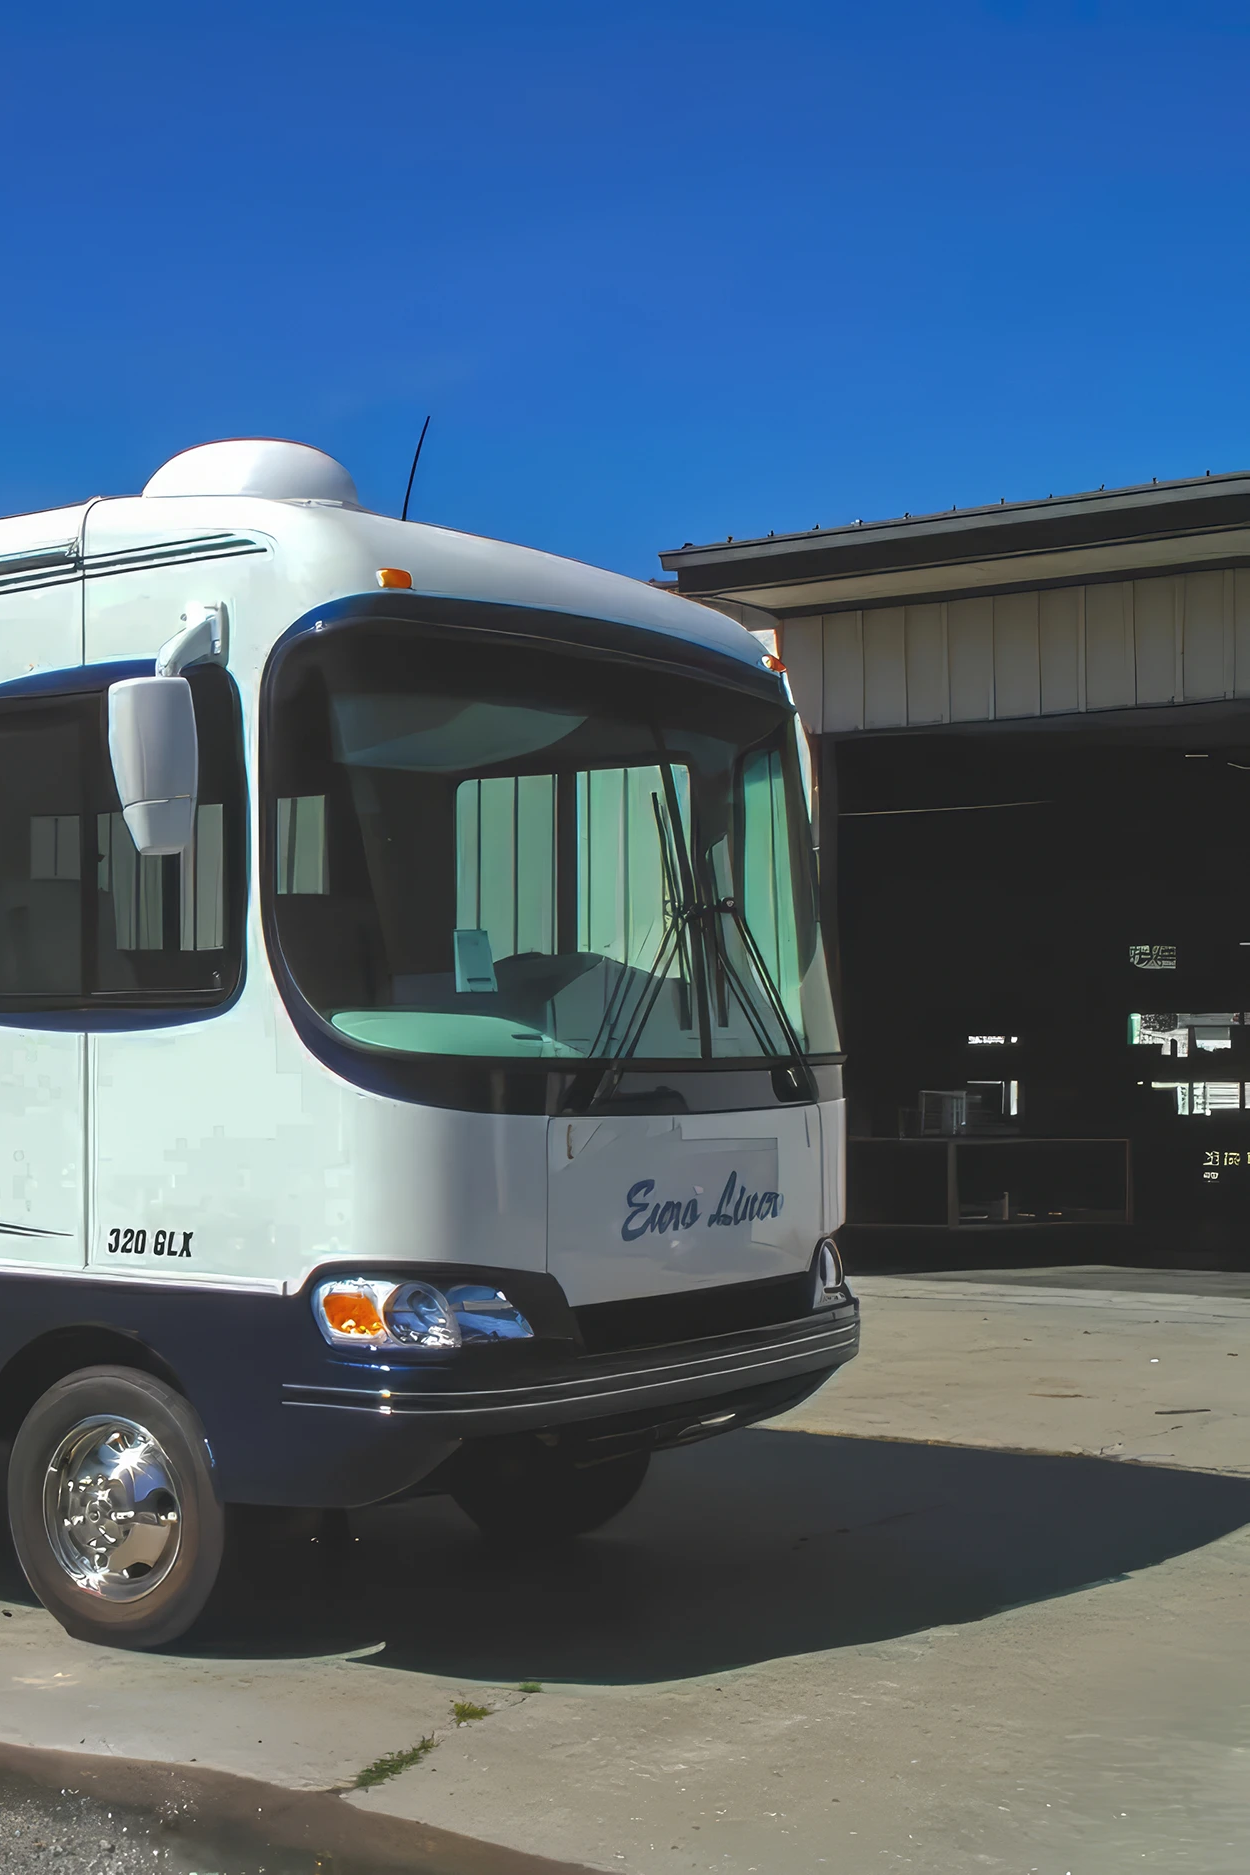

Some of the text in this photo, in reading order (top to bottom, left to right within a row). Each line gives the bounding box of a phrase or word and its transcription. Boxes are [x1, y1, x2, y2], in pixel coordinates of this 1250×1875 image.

[621, 1170, 785, 1242] Euro Liner
[107, 1228, 194, 1258] 320 GLX
